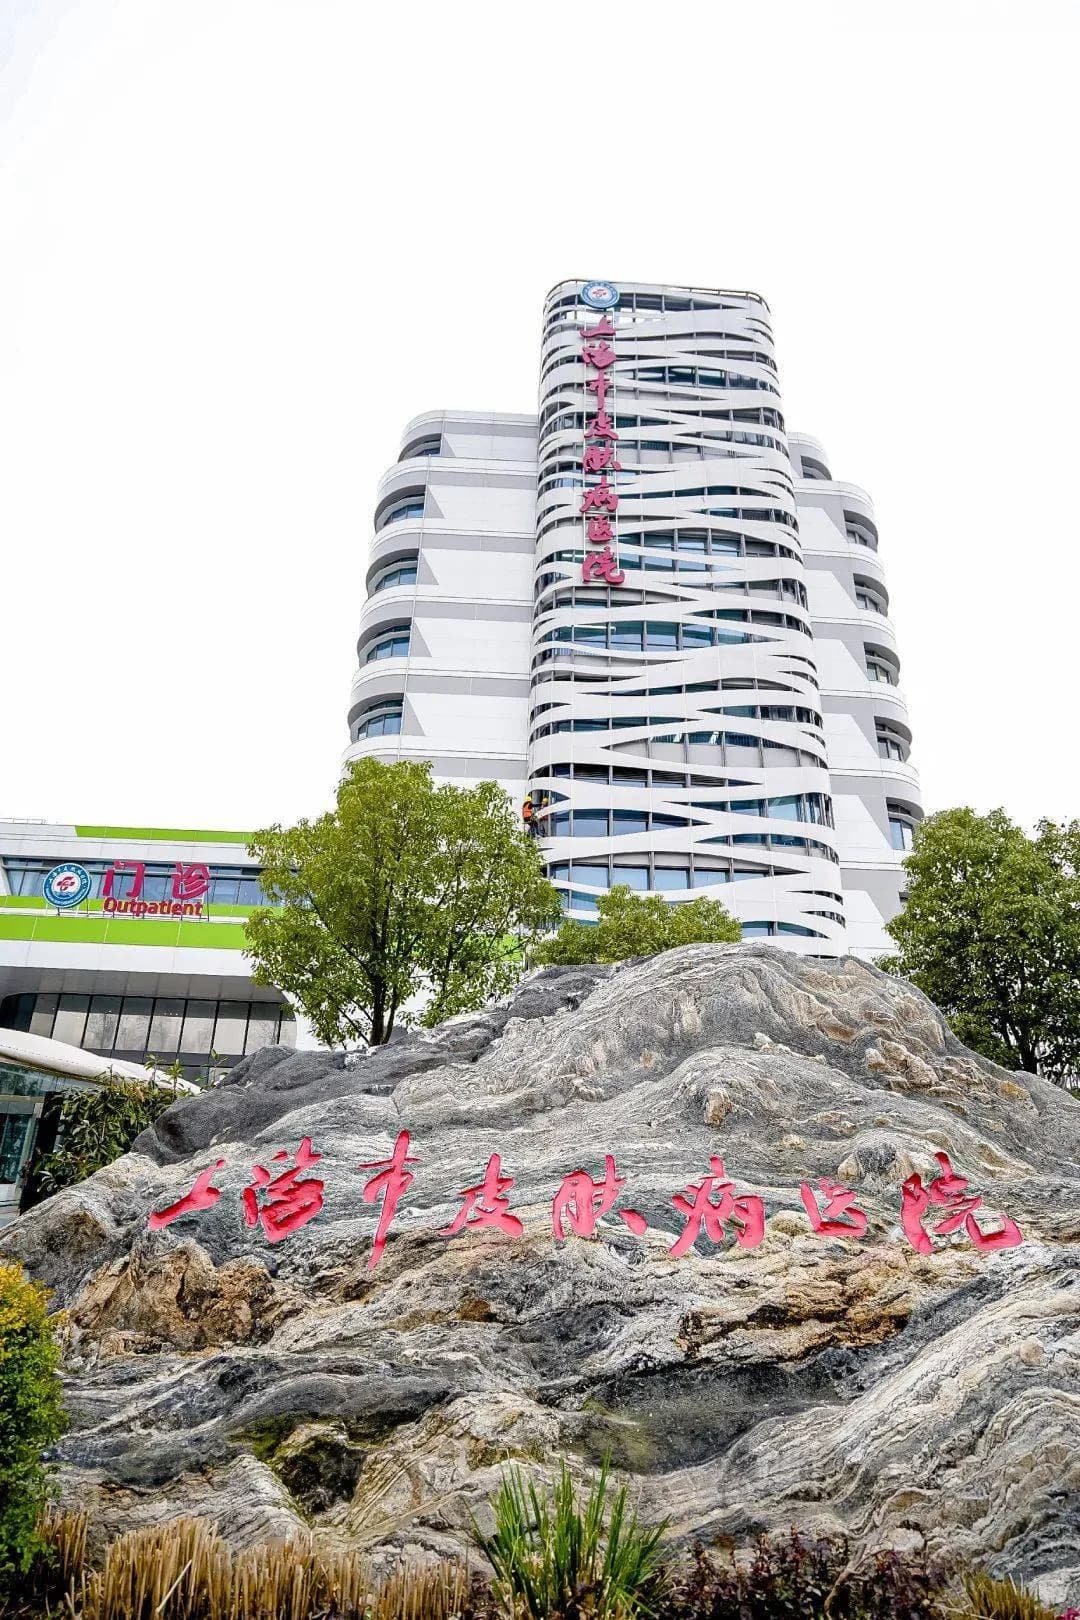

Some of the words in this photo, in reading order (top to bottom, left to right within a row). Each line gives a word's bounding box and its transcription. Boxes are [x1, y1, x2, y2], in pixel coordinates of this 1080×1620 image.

[580, 316, 625, 584] 上海市皮肤病医院
[103, 861, 210, 900] 门诊
[104, 896, 203, 917] Outpatient
[149, 1129, 1023, 1269] 上海市皮肤病医院
